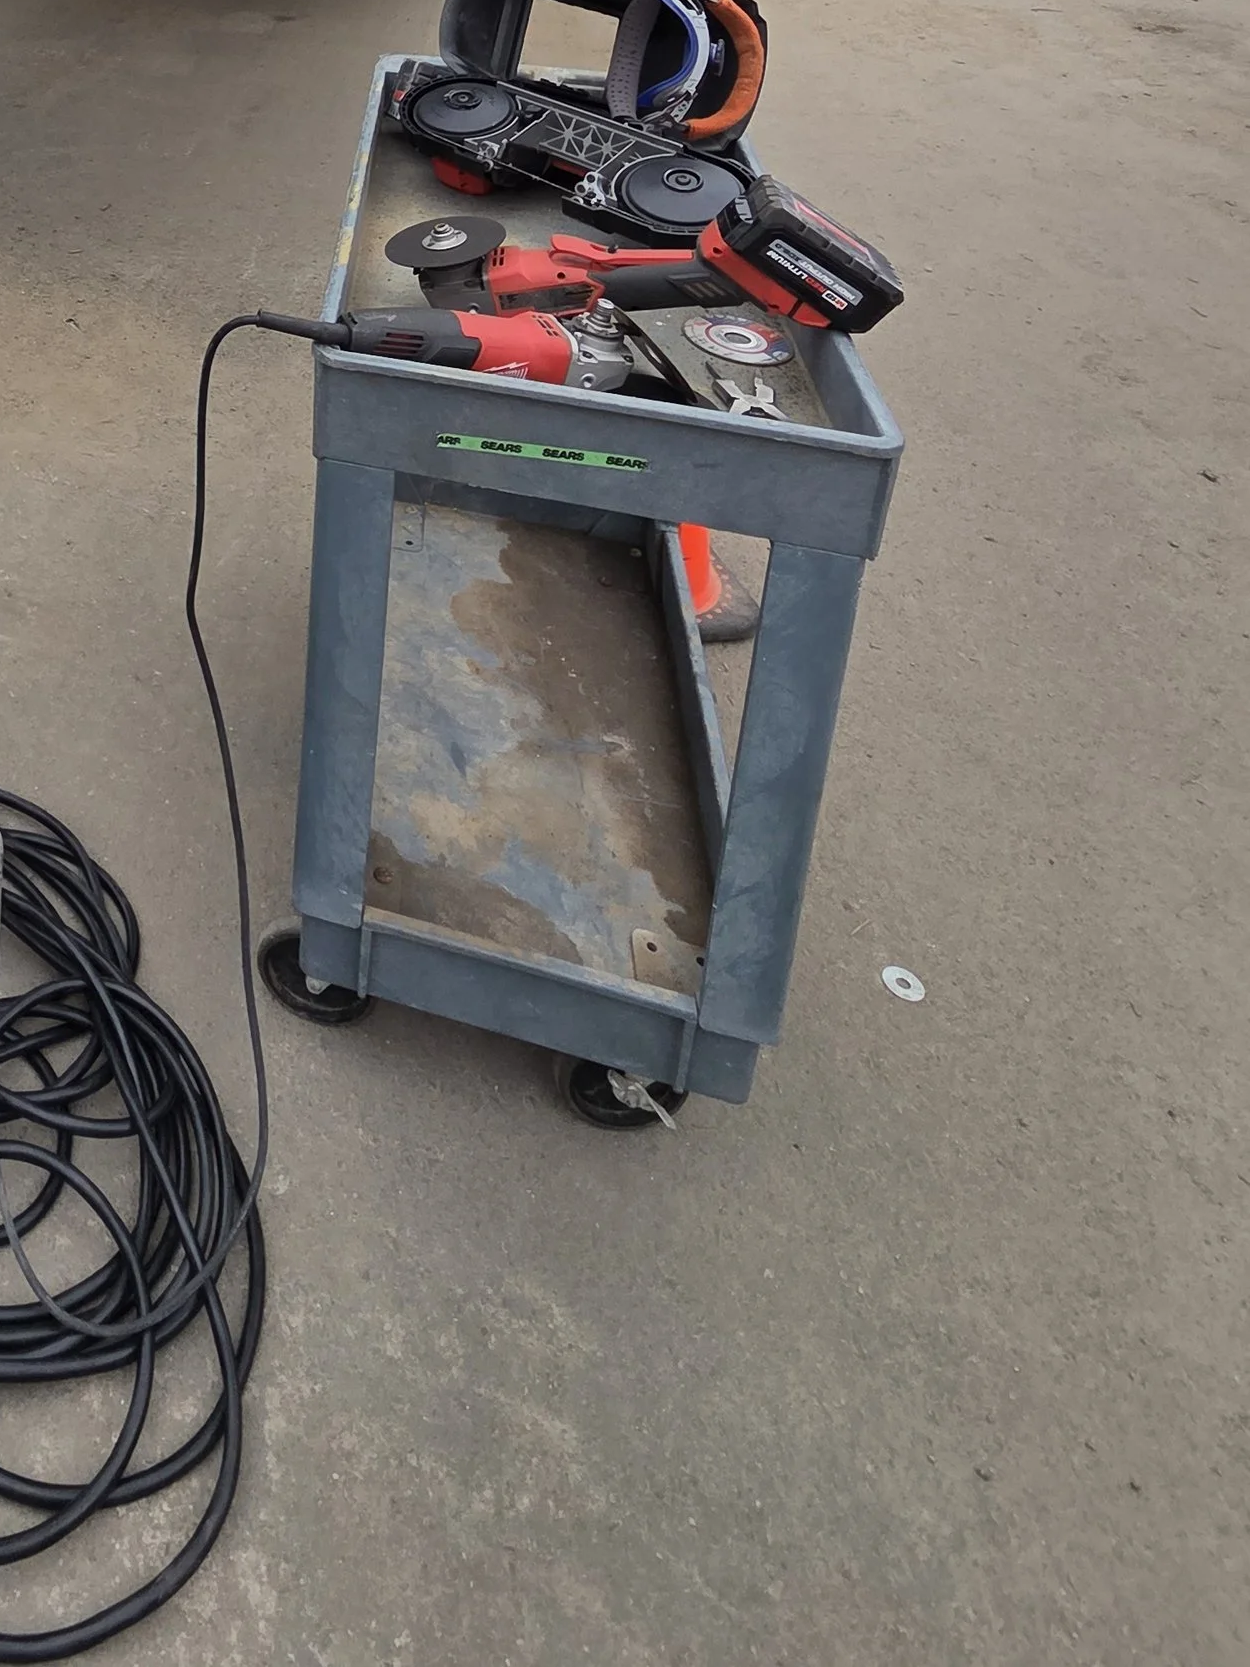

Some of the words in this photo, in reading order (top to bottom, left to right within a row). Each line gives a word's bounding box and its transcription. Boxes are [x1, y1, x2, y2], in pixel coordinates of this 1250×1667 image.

[800, 261, 834, 285] OUTPUT
[833, 283, 856, 301] HIGH
[480, 440, 522, 454] SEARS
[542, 448, 585, 461] SEARS
